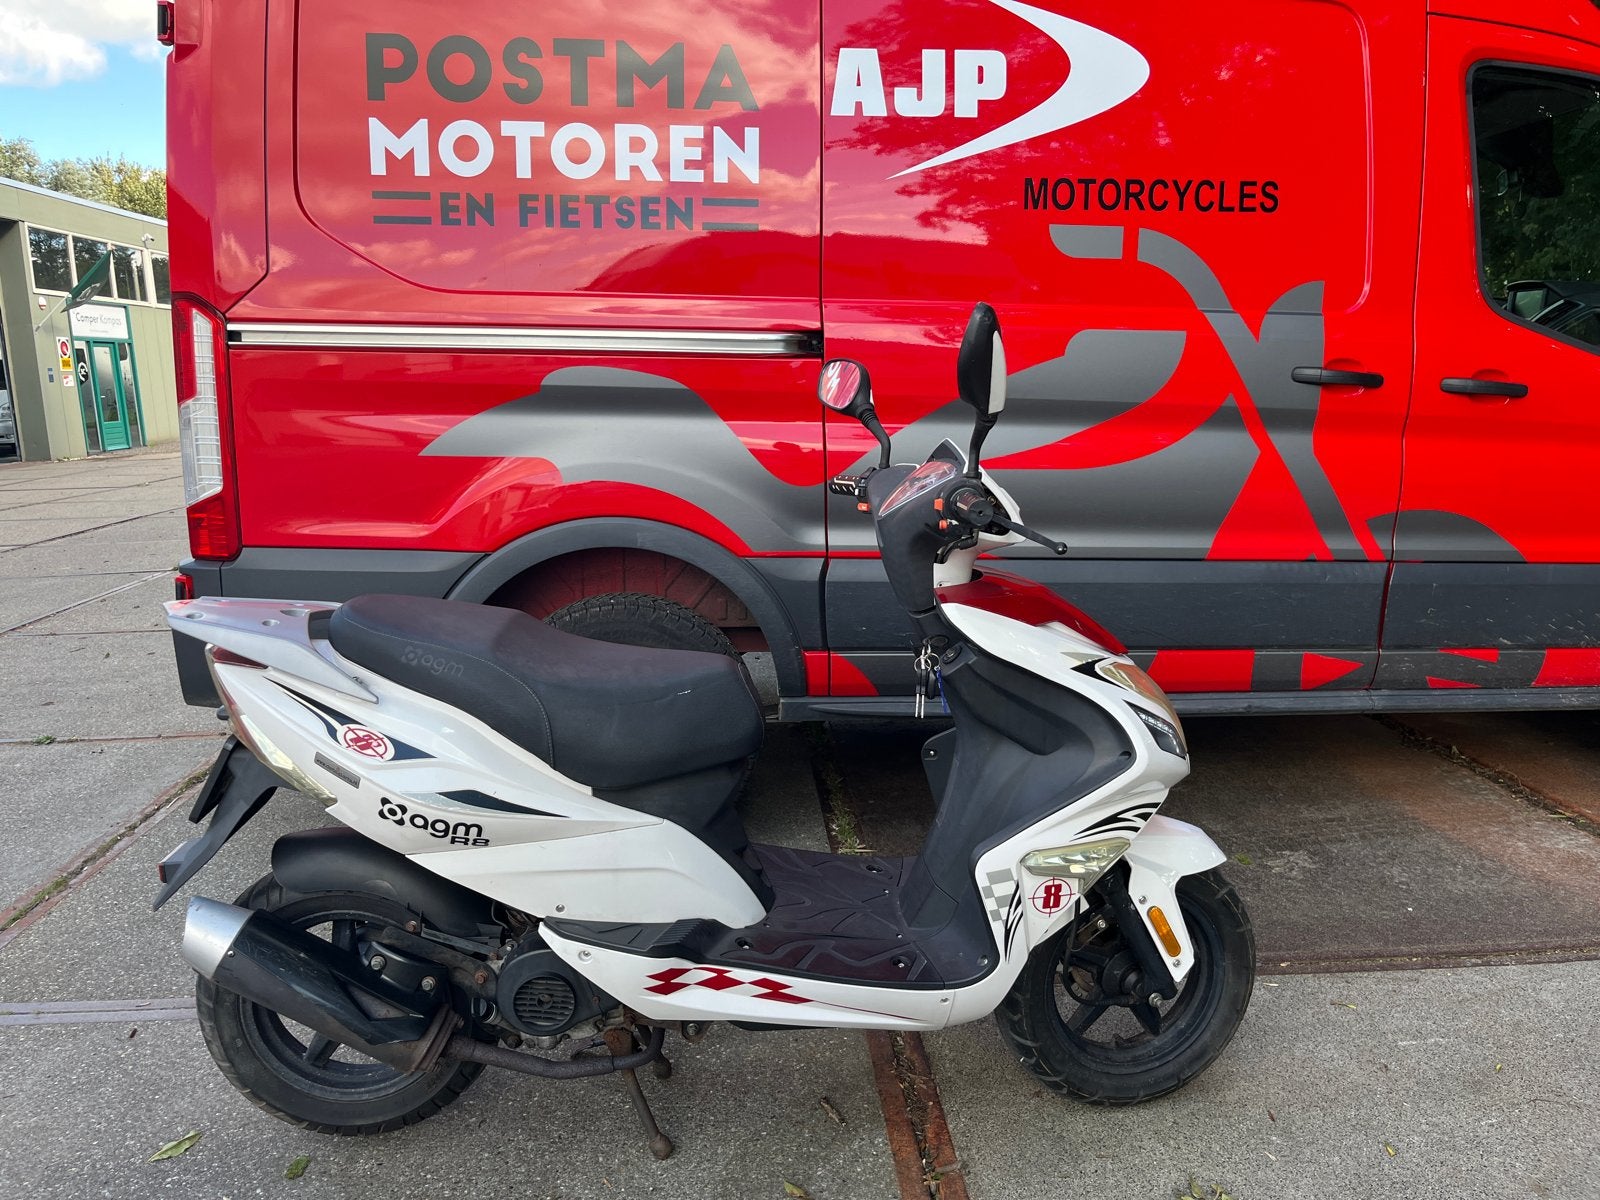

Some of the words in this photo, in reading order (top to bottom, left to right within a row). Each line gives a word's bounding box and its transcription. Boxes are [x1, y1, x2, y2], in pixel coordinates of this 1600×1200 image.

[365, 33, 760, 111] POSTMA
[830, 48, 1007, 118] AJP
[368, 117, 760, 184] MOTOREN
[440, 192, 495, 227] EN
[518, 194, 694, 230] FIETSEN
[1023, 177, 1280, 213] MOTORCYCLES
[421, 654, 464, 677] agm
[409, 813, 483, 839] agm
[450, 836, 490, 847] R8
[1042, 883, 1062, 909] 8
